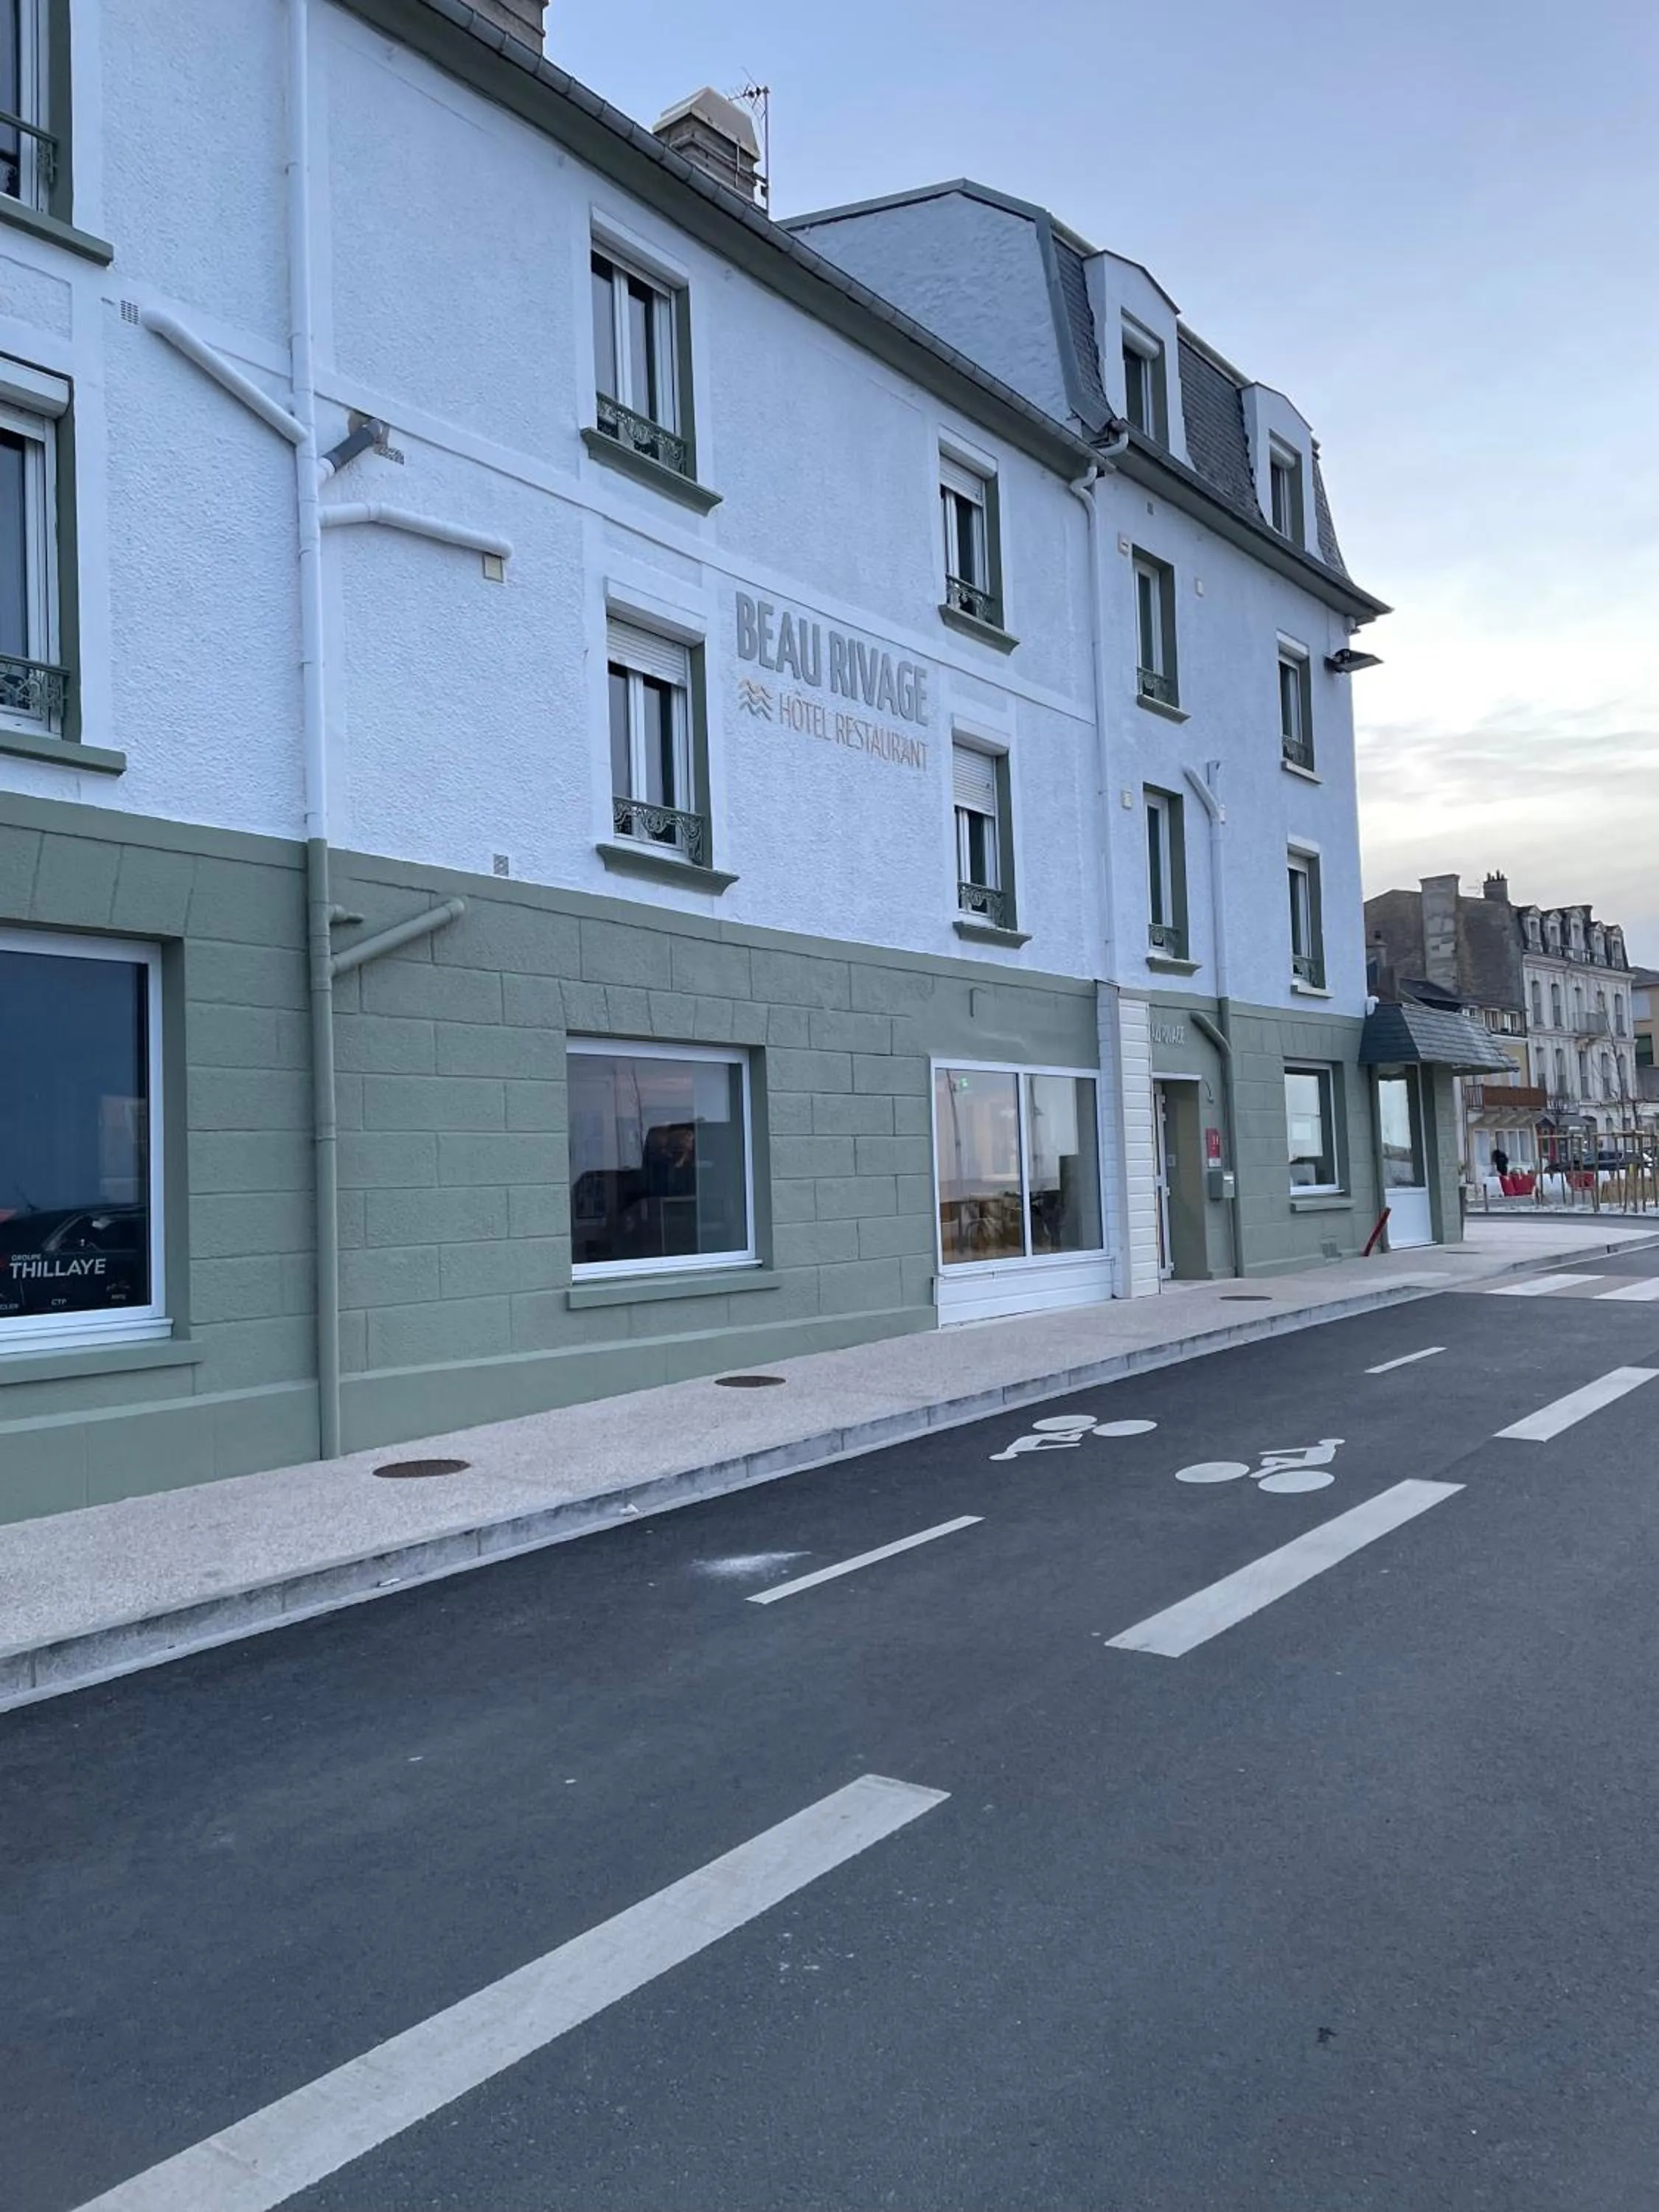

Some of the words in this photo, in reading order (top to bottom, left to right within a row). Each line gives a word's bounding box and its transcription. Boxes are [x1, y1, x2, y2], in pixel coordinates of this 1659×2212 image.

[736, 591, 822, 687] BEAU
[829, 630, 928, 727] RIVAGE
[779, 690, 832, 740] HÔTEL
[835, 712, 929, 771] RESTAURANT
[10, 1258, 106, 1279] THILLAYE
